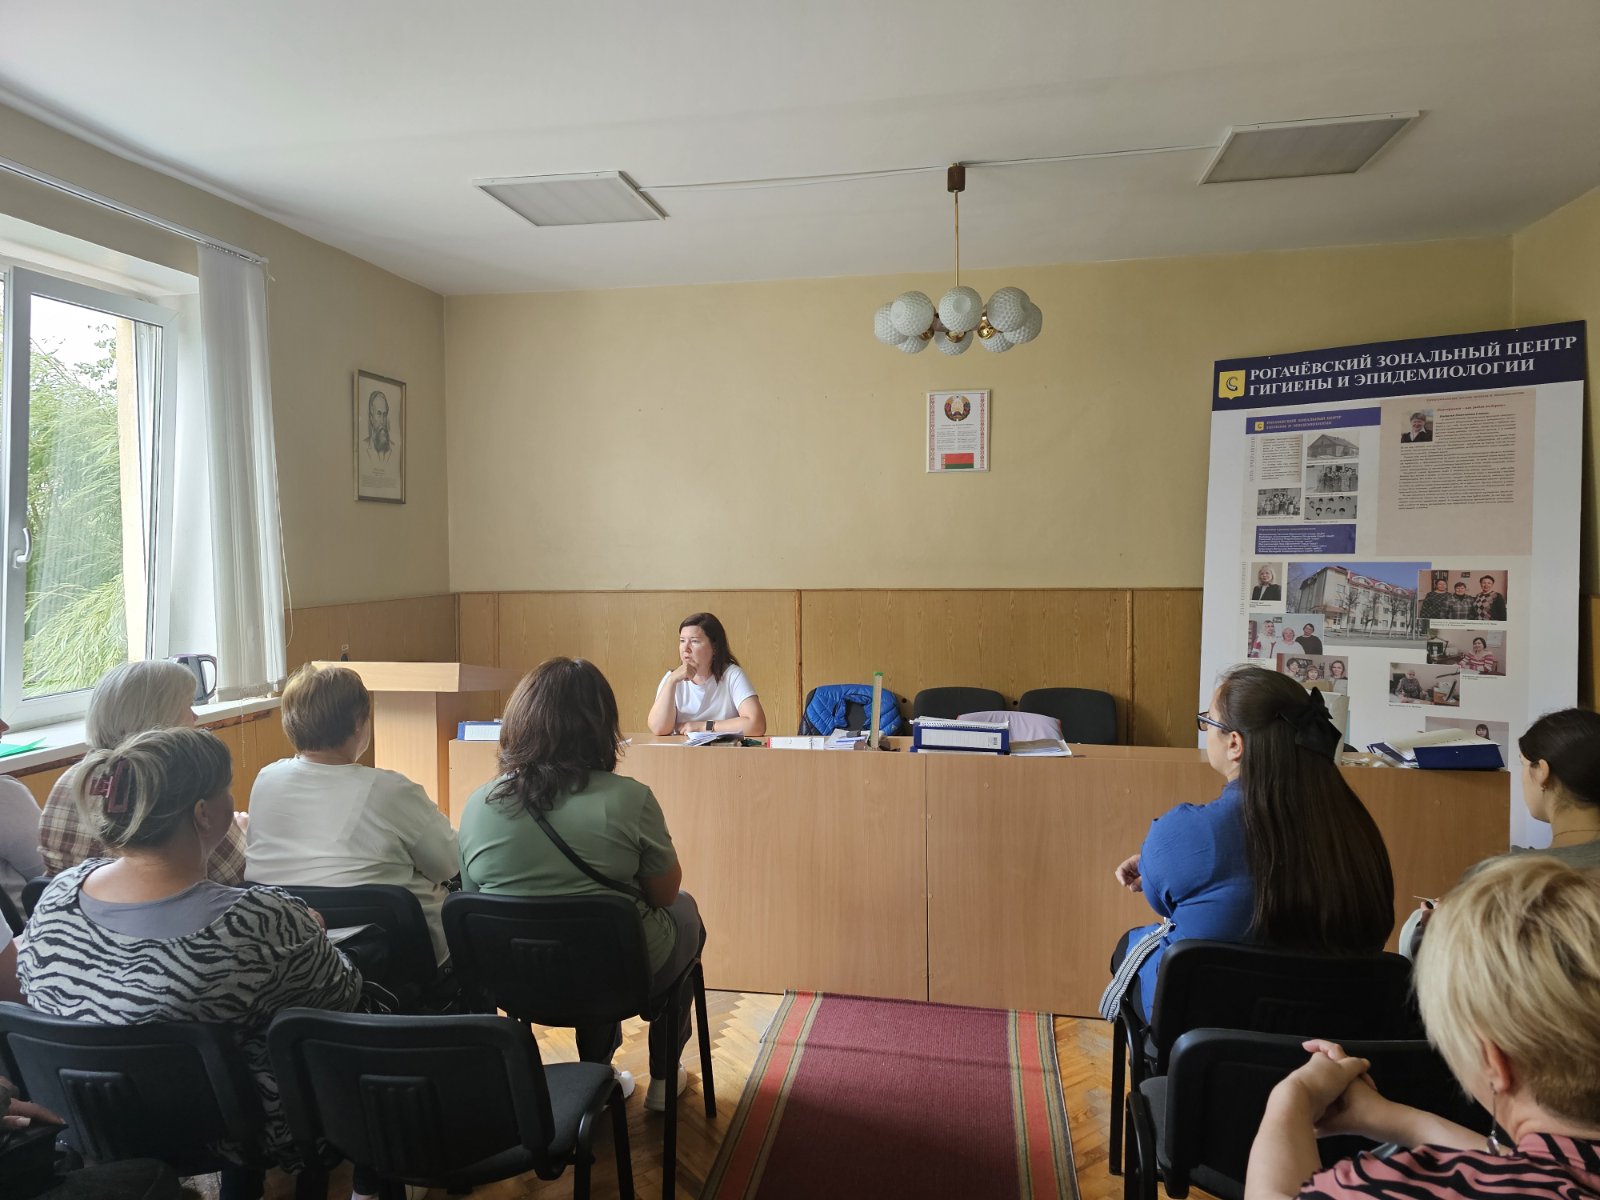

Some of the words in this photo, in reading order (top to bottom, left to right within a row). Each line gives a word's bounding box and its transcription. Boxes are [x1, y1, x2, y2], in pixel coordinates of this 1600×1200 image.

[1249, 377, 1332, 396] ГИГИЕНЫ
[1337, 375, 1350, 387] И
[1354, 358, 1535, 387] ЭПИДЕМИОЛОГИИ
[1250, 354, 1372, 381] РОГАЧЁВСКИЙ
[1376, 342, 1501, 367] ЗОНАЛЬНЫЙ
[1507, 336, 1578, 356] ЦЕНТР
